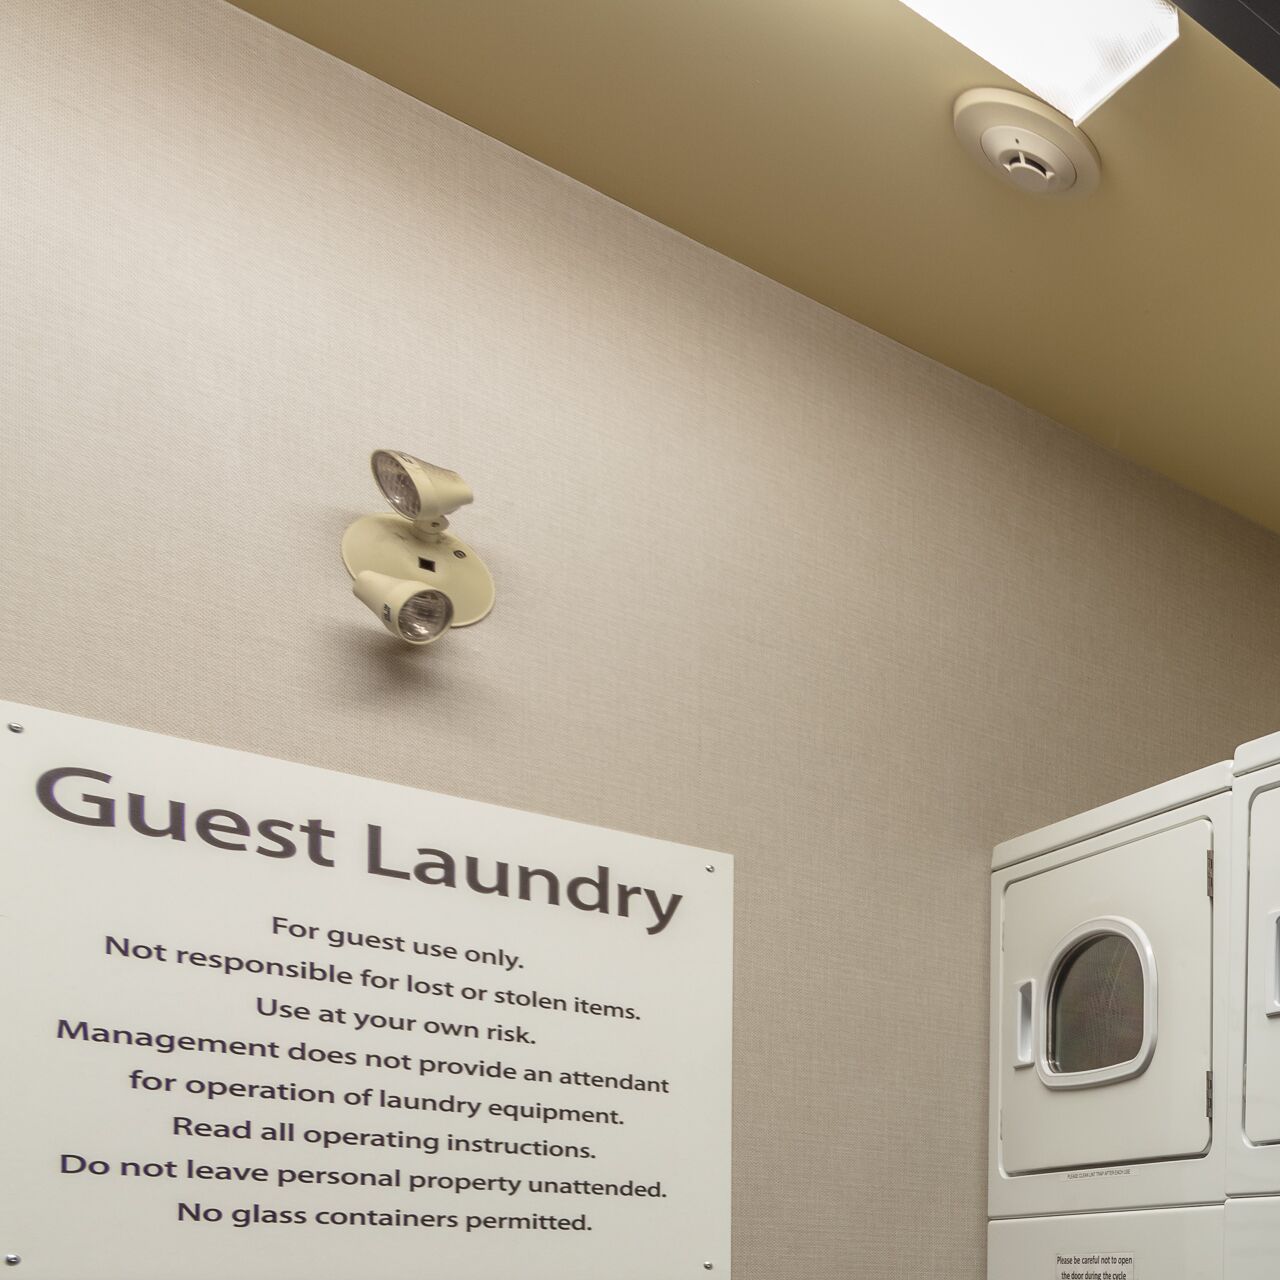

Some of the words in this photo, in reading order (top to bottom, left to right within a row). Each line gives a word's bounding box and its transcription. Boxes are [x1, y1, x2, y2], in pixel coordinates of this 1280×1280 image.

[36, 767, 334, 867] Guest
[368, 824, 683, 935] Laundry
[273, 917, 319, 939] For
[328, 930, 405, 952] guest
[414, 942, 457, 959] use
[465, 949, 523, 971] only.
[106, 936, 166, 961] Not
[177, 950, 352, 984] responsible
[360, 969, 399, 989] for
[408, 975, 454, 997] lost
[461, 987, 487, 1000] or
[495, 991, 566, 1011] stolen
[575, 997, 640, 1020] items.
[257, 998, 310, 1020] Use
[319, 1009, 346, 1024] at
[354, 1013, 416, 1031] your
[424, 1021, 478, 1038] own
[488, 1025, 535, 1044] risk.
[57, 1020, 279, 1058] Management
[288, 1043, 357, 1065] does
[366, 1054, 411, 1070] not
[420, 1059, 516, 1079] provide
[524, 1069, 552, 1082] an
[560, 1072, 669, 1093] attendant
[129, 1070, 176, 1091] for
[186, 1080, 334, 1103] operation
[344, 1089, 373, 1106] of
[380, 1090, 482, 1118] laundry
[488, 1103, 623, 1124] equipment.
[174, 1117, 251, 1139] Read
[261, 1123, 294, 1141] all
[304, 1130, 439, 1154] operating
[448, 1134, 595, 1158] instructions.
[61, 1155, 110, 1175] Do
[121, 1162, 177, 1178] not
[188, 1160, 268, 1181] leave
[278, 1169, 400, 1187] personal
[410, 1175, 521, 1196] property
[529, 1180, 666, 1197] unattended.
[178, 1203, 222, 1222] No
[232, 1204, 307, 1227] glass
[315, 1209, 458, 1227] containers
[466, 1214, 592, 1232] permitted.
[1057, 1256, 1072, 1264] Please
[1074, 1256, 1080, 1264] be
[1082, 1256, 1099, 1264] careful
[1101, 1256, 1110, 1264] not
[1118, 1257, 1132, 1266] open
[1061, 1272, 1070, 1280] the
[1071, 1271, 1083, 1280] door
[1085, 1271, 1101, 1280] during
[1103, 1272, 1111, 1280] the
[1113, 1272, 1126, 1280] cycle
